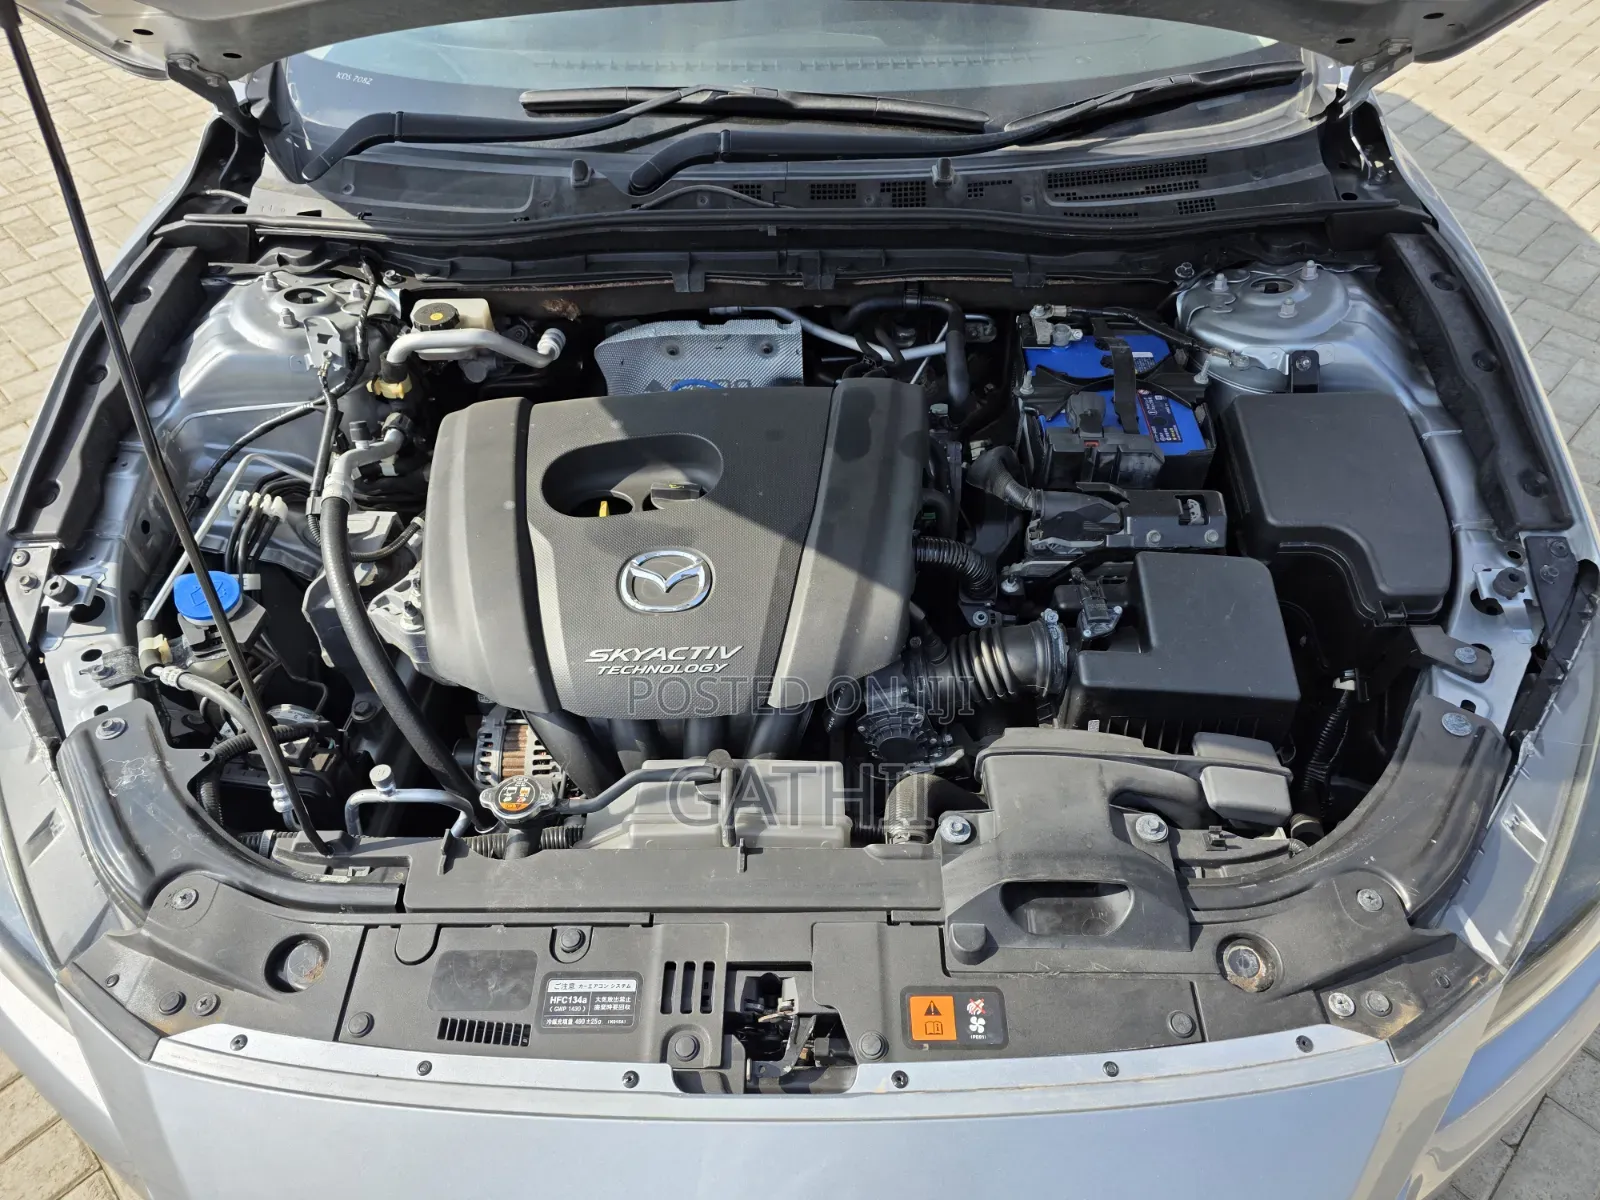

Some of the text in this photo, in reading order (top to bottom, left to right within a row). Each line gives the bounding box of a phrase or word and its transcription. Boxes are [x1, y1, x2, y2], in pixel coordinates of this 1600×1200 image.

[585, 645, 744, 663] SKYACTIV
[597, 663, 729, 675] TECHNOLOGY
[550, 996, 588, 1004] HFC134a
